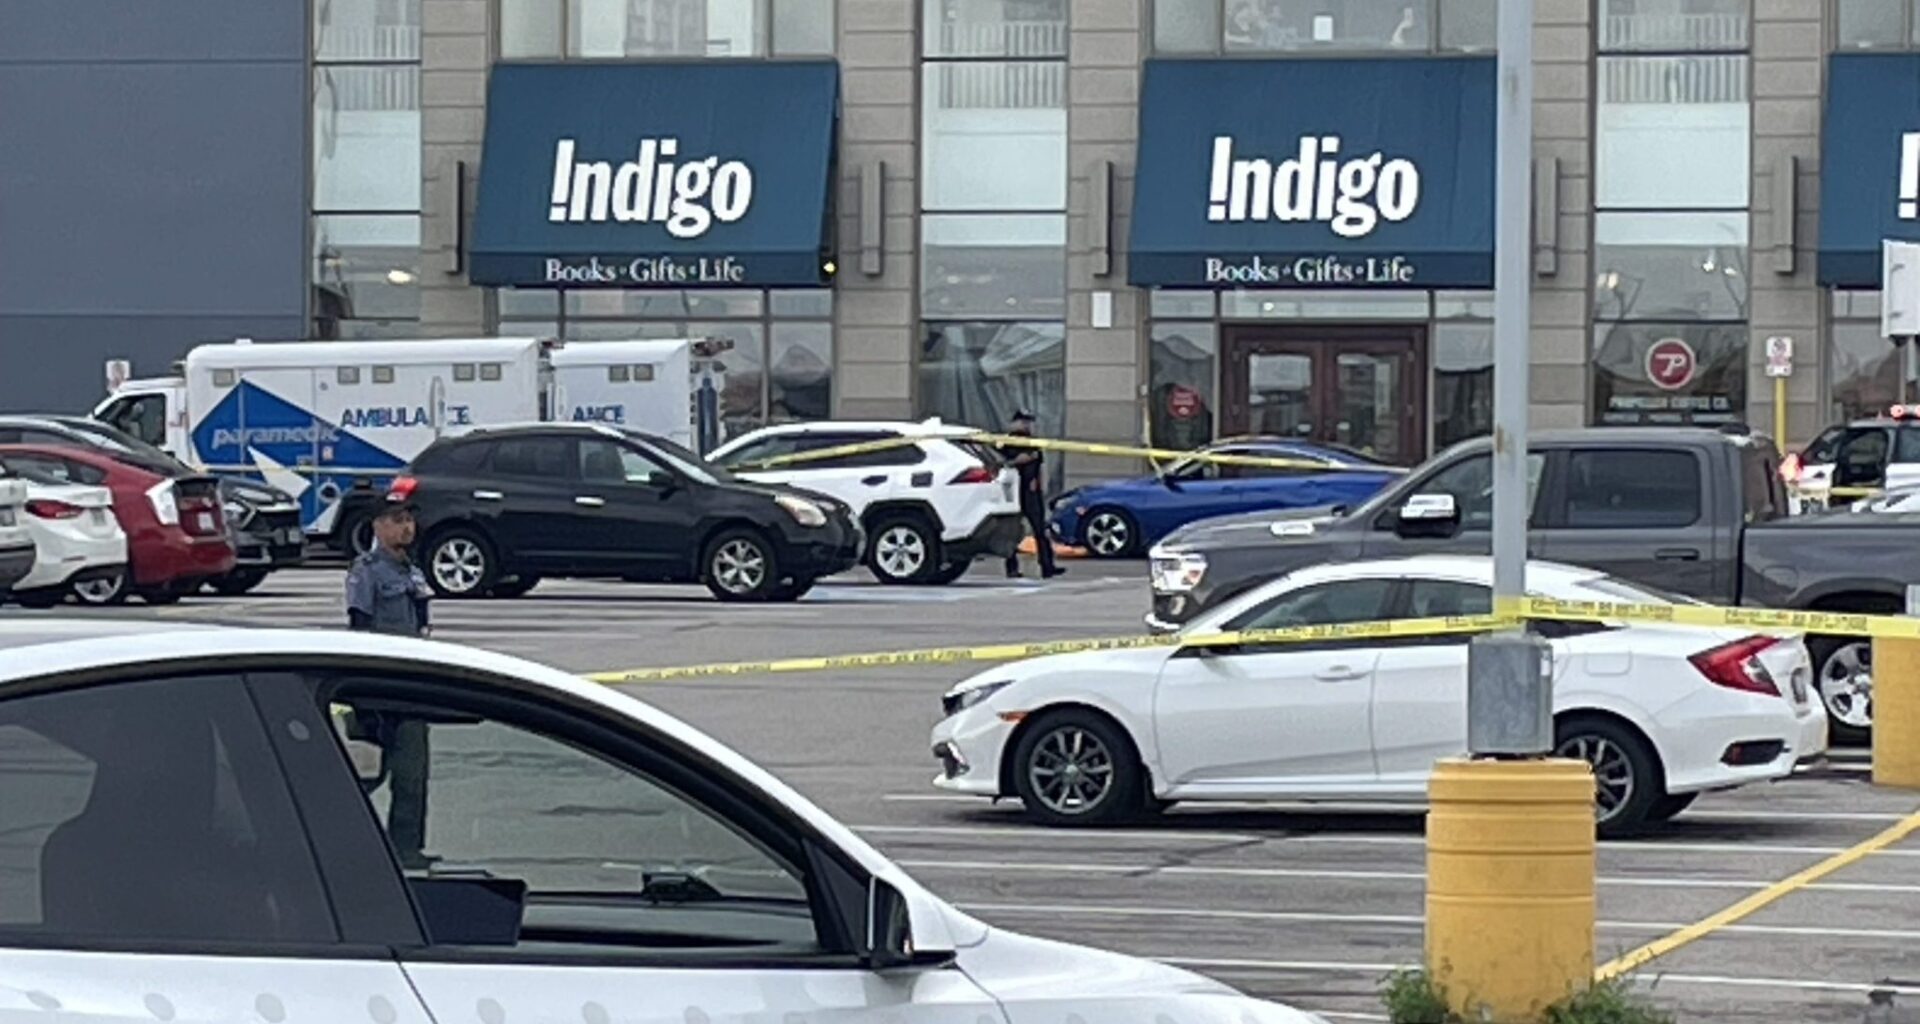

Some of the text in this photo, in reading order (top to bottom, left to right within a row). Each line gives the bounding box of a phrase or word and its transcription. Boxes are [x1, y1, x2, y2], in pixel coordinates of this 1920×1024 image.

[545, 255, 745, 282] Books Gifts Life
[1205, 255, 1415, 283] Books Gifts Life
[340, 405, 473, 428] AMBULACE
[212, 424, 341, 450] paramedic
